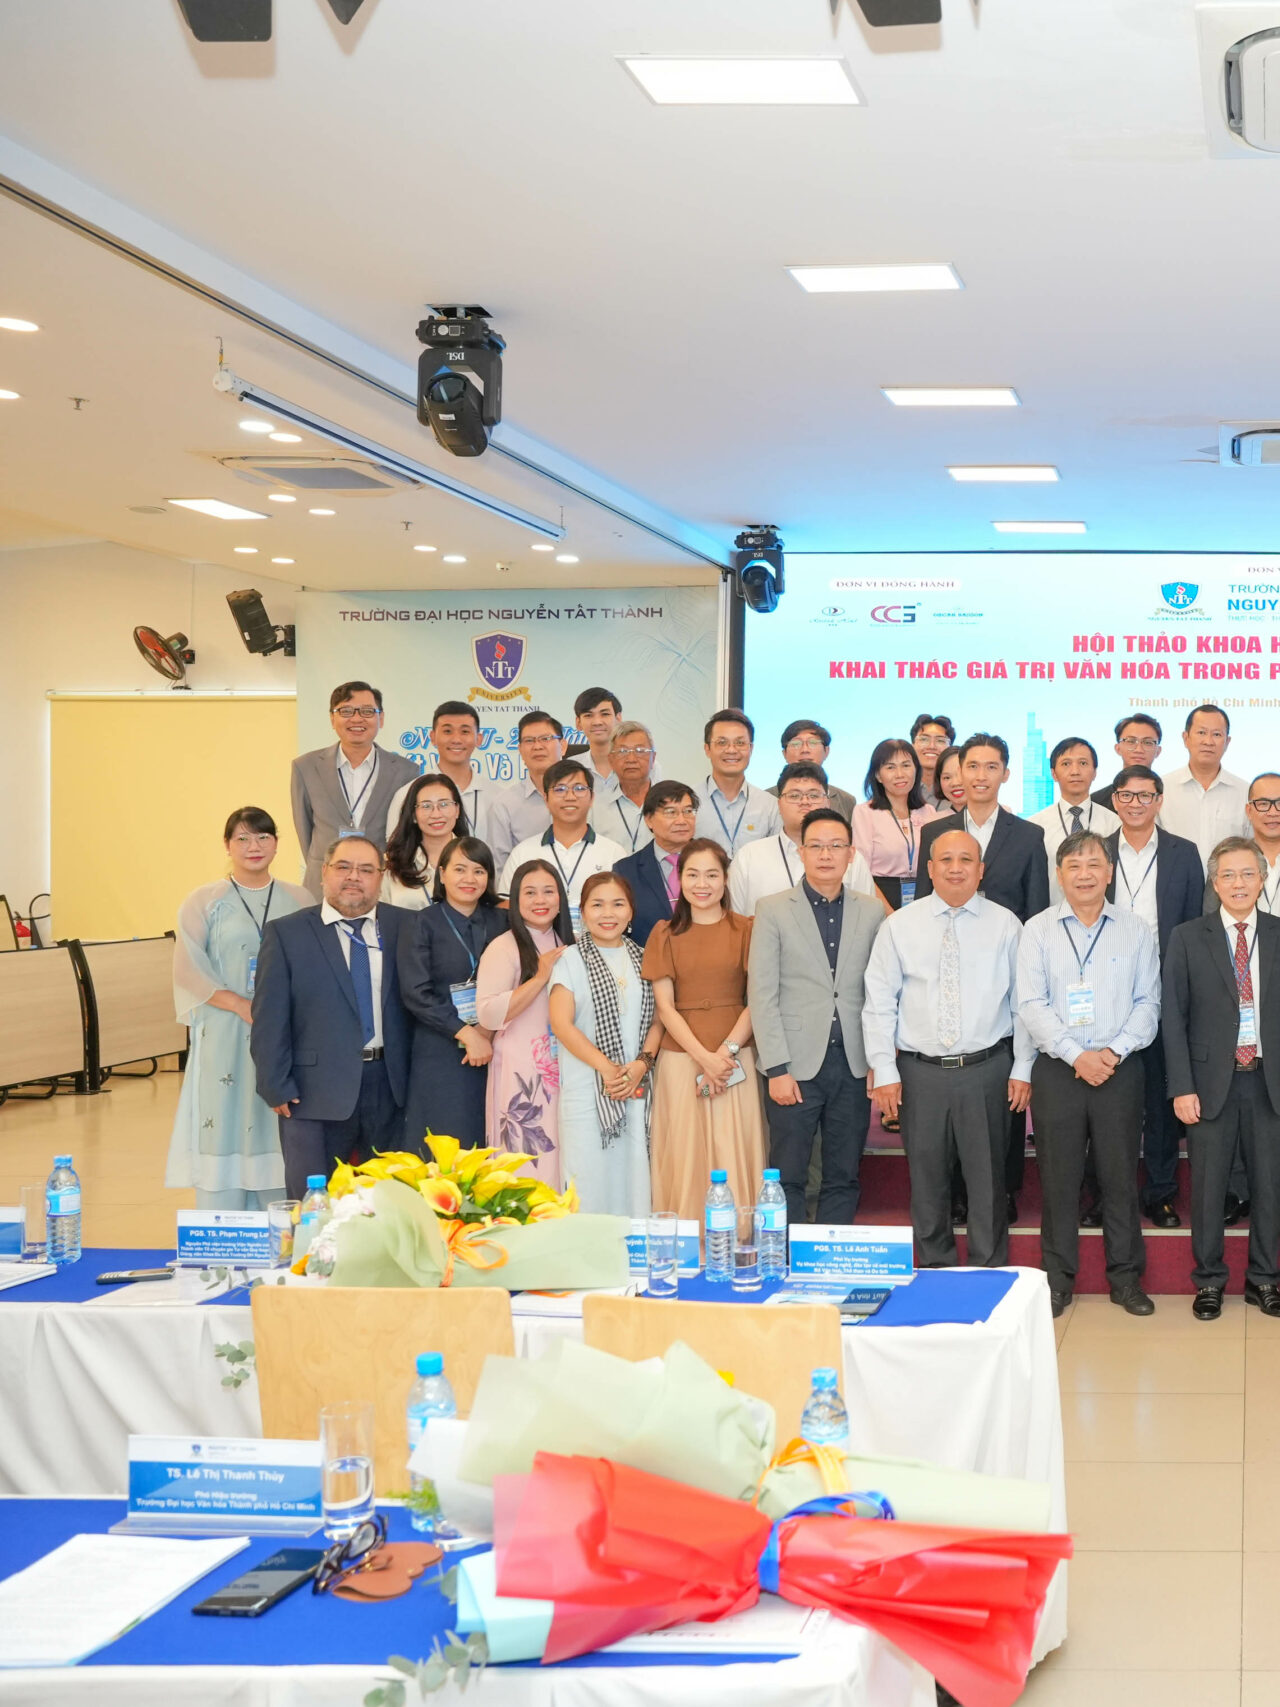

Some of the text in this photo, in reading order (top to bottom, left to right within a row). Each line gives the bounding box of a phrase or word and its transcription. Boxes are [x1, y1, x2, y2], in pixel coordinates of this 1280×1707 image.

[446, 352, 465, 361] DSL
[339, 604, 663, 624] TRƯỜNG ĐẠI HỌC NGUYỄN TẤT THÀNH
[1073, 632, 1115, 656] HỘI
[1123, 631, 1187, 653] THẢO
[1197, 635, 1262, 654] KHOA
[485, 661, 515, 679] NTT
[829, 661, 886, 679] KHAI
[894, 658, 957, 680] THÁC
[966, 658, 1007, 679] GIÁ
[1016, 661, 1055, 683] TRỊ
[1063, 658, 1111, 680] VĂN
[1120, 659, 1170, 680] HÓA
[1178, 662, 1260, 680] TRONG
[485, 753, 514, 781] Và
[166, 1467, 285, 1483] TS. Lê Thị Thanh Thúy
